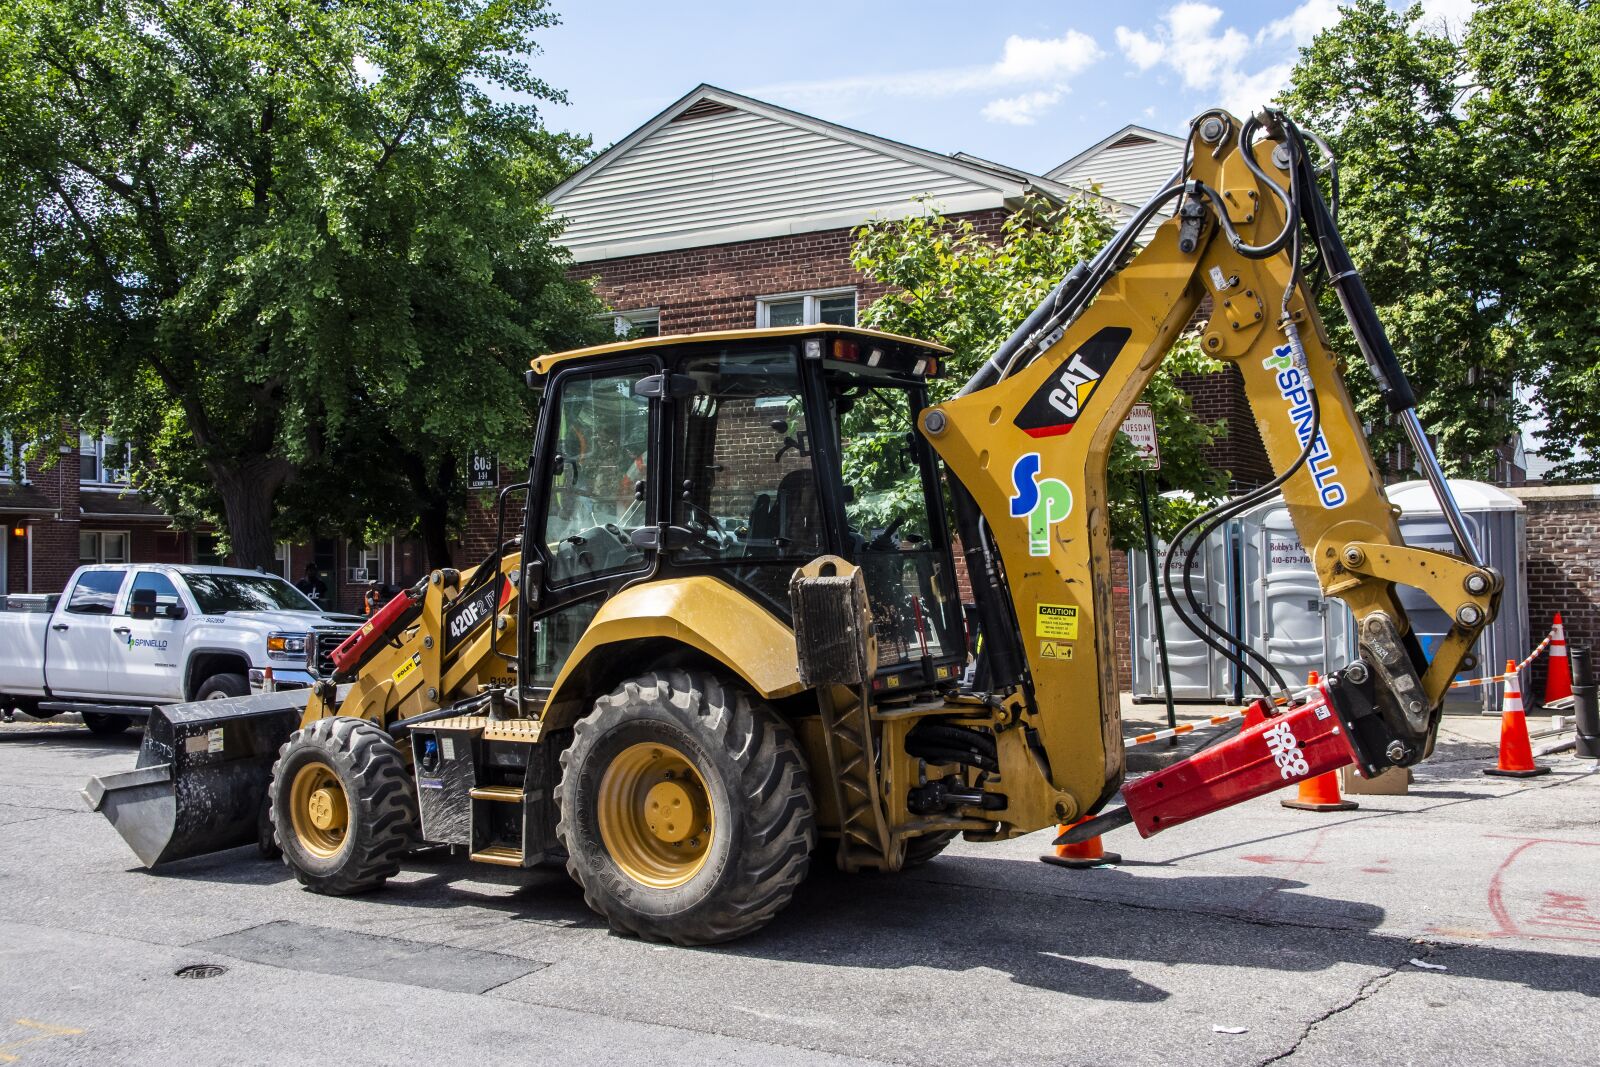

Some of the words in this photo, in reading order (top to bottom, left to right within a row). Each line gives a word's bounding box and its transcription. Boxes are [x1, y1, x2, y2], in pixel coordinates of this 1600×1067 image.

[1048, 353, 1101, 418] CAT
[1122, 423, 1151, 432] TUESDAY
[1271, 556, 1314, 564] 410-679-710
[1041, 607, 1075, 616] CAUTION
[134, 638, 168, 648] SPINIELLO
[397, 662, 413, 678] FOLEY
